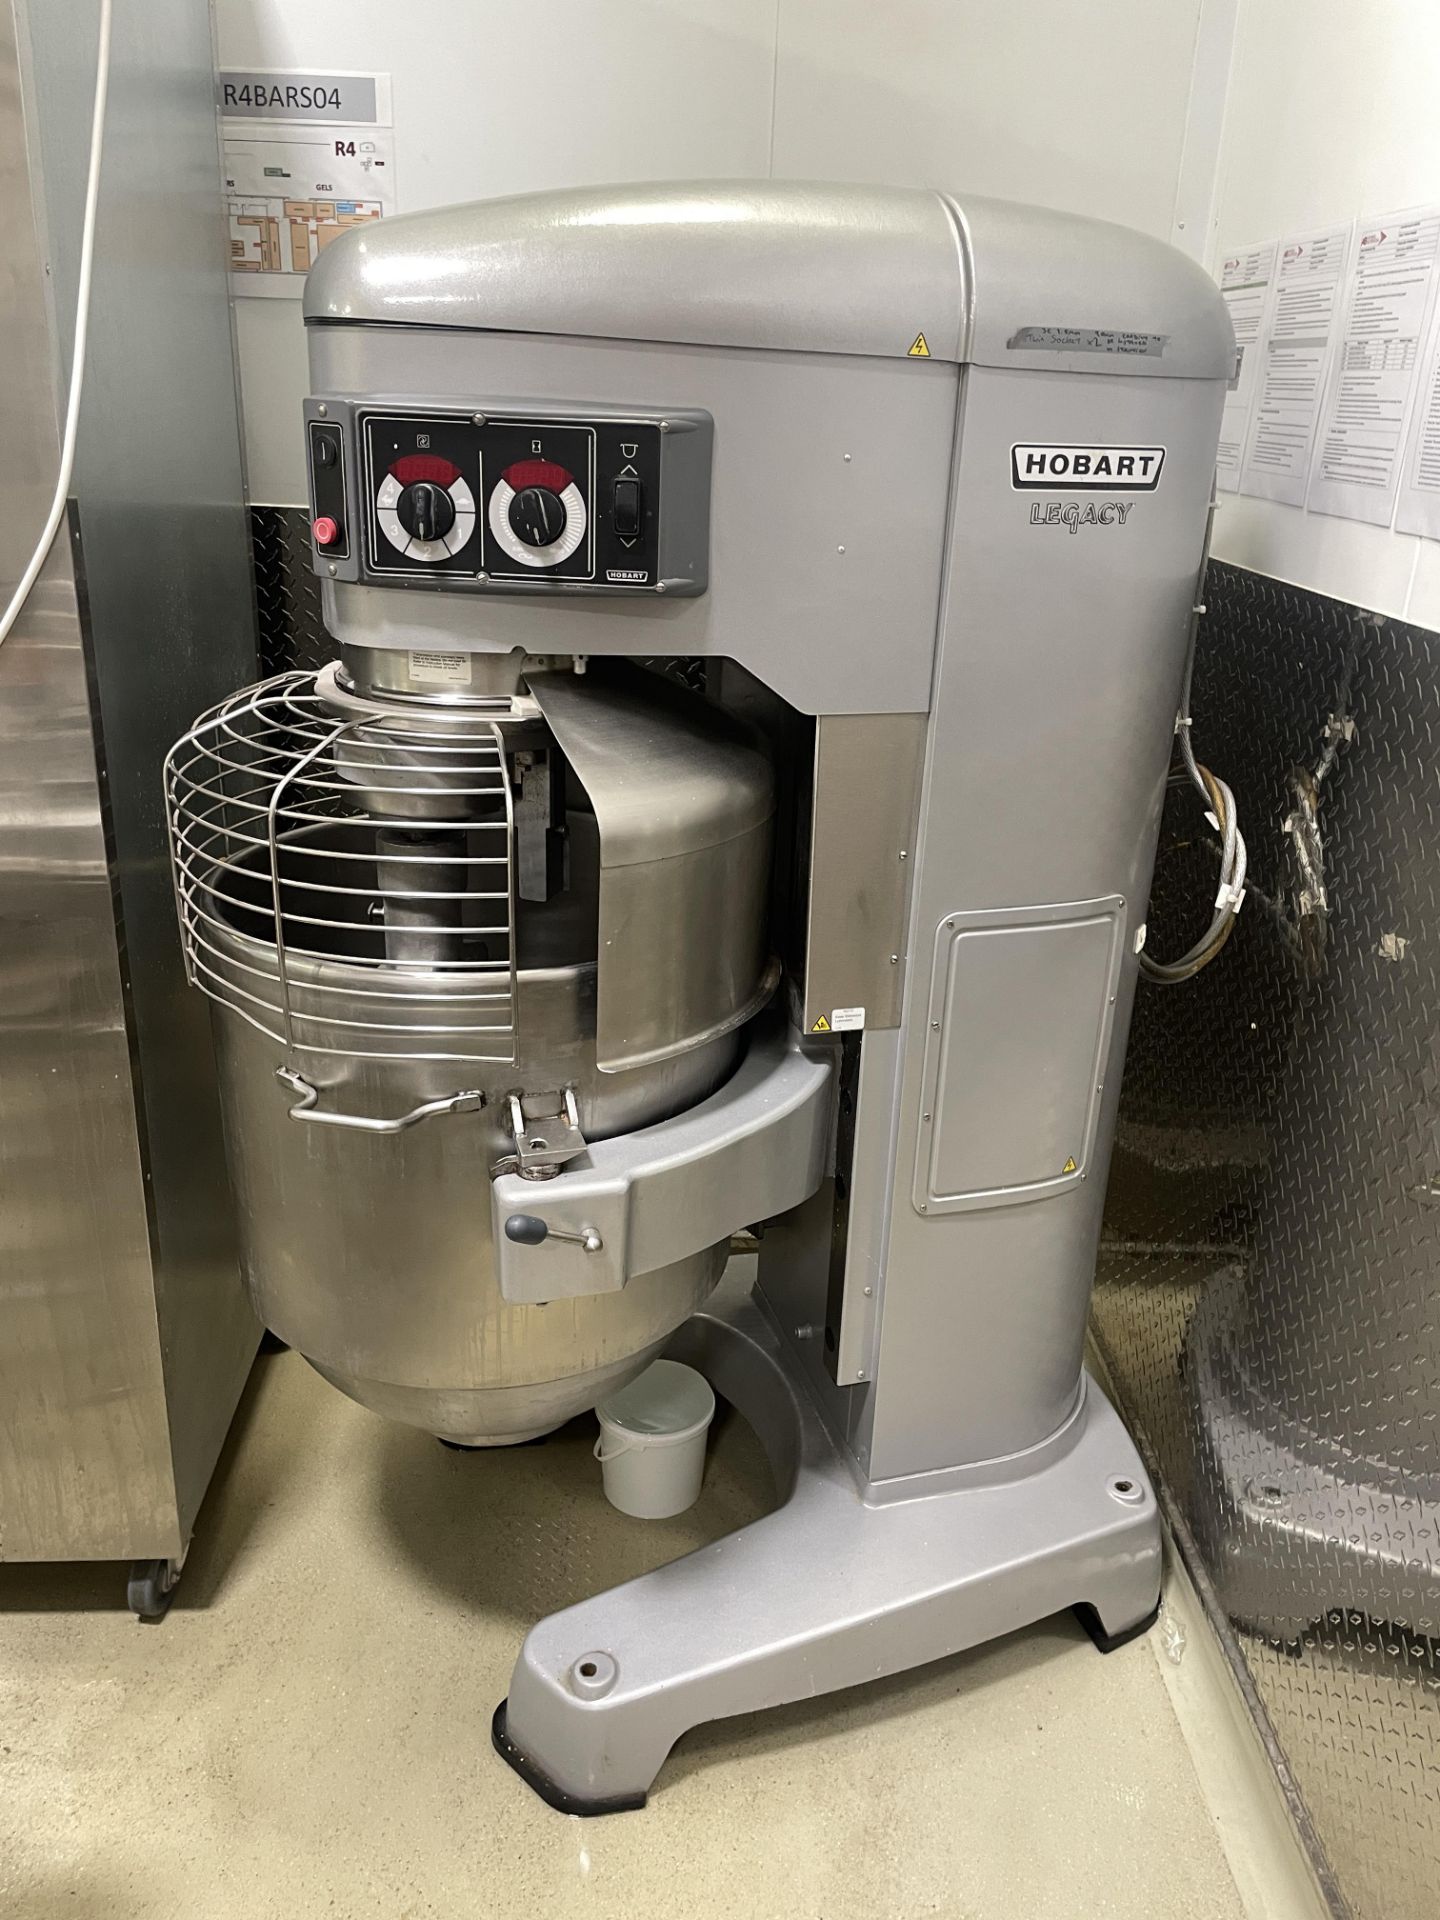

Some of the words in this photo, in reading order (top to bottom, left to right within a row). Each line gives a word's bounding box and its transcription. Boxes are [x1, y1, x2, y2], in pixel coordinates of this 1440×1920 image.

[223, 84, 342, 110] R4BARS04
[334, 141, 357, 157] R4
[315, 183, 333, 192] GELS
[1025, 453, 1155, 476] HOBART
[386, 484, 395, 494] 4
[1029, 502, 1134, 535] LEGACY
[390, 525, 398, 536] 3
[423, 546, 432, 558] 2
